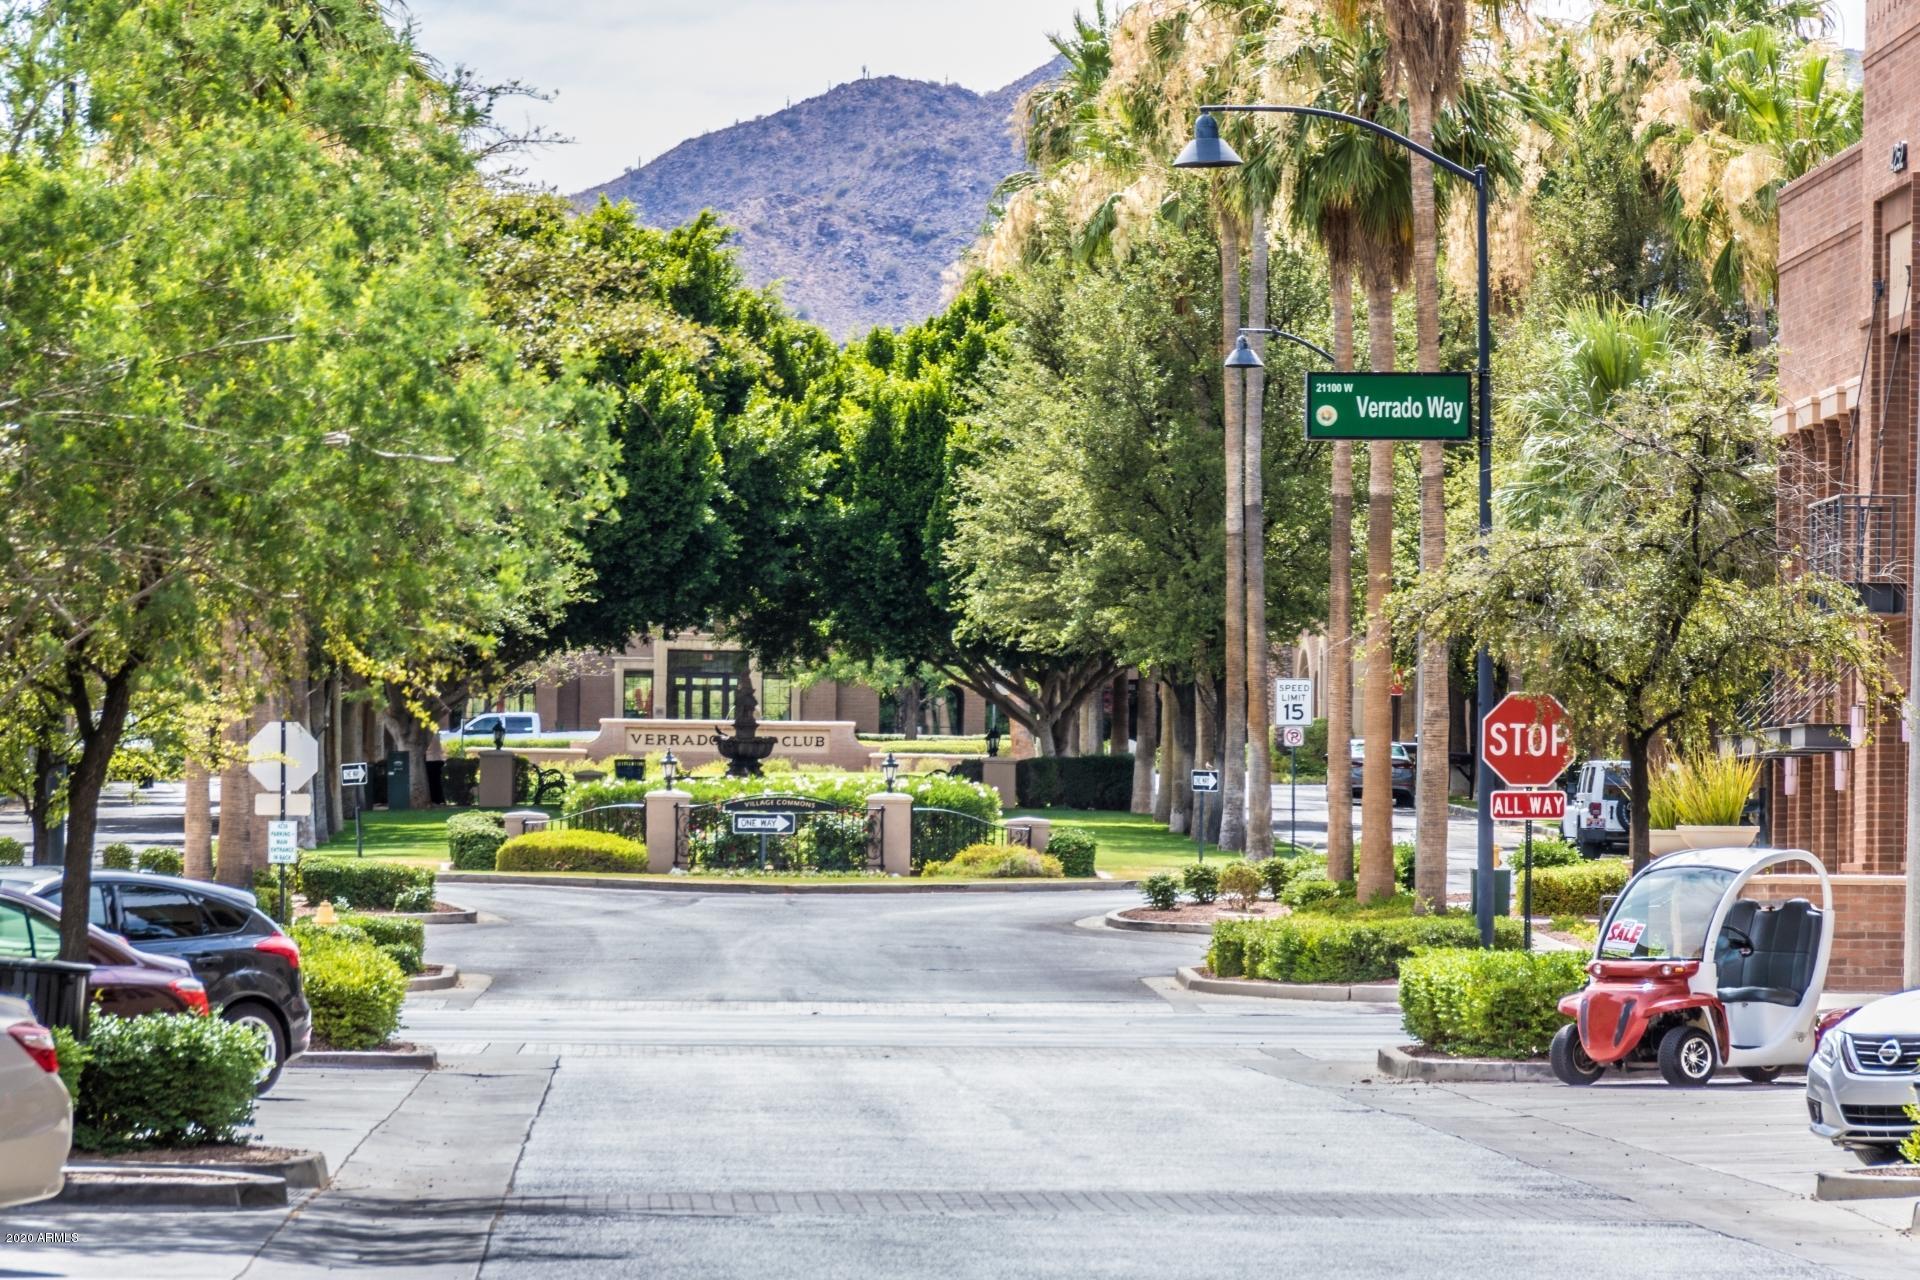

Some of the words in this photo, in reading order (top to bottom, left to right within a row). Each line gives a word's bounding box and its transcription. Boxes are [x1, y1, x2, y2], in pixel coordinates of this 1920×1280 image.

[1316, 383, 1342, 393] 21100
[1344, 383, 1353, 392] W
[1356, 396, 1423, 418] Verrado
[1427, 396, 1463, 424] Way
[1279, 684, 1310, 692] SPEED
[1284, 703, 1304, 720] 15
[782, 736, 825, 747] CLUB
[1489, 722, 1570, 757] STOP
[744, 800, 775, 808] VILLAGE
[776, 799, 816, 809] COMMONS
[1493, 796, 1523, 814] ALL
[1530, 796, 1563, 814] WAY
[741, 818, 757, 827] ONE
[760, 818, 777, 827] WAY
[1607, 922, 1645, 944] SALE
